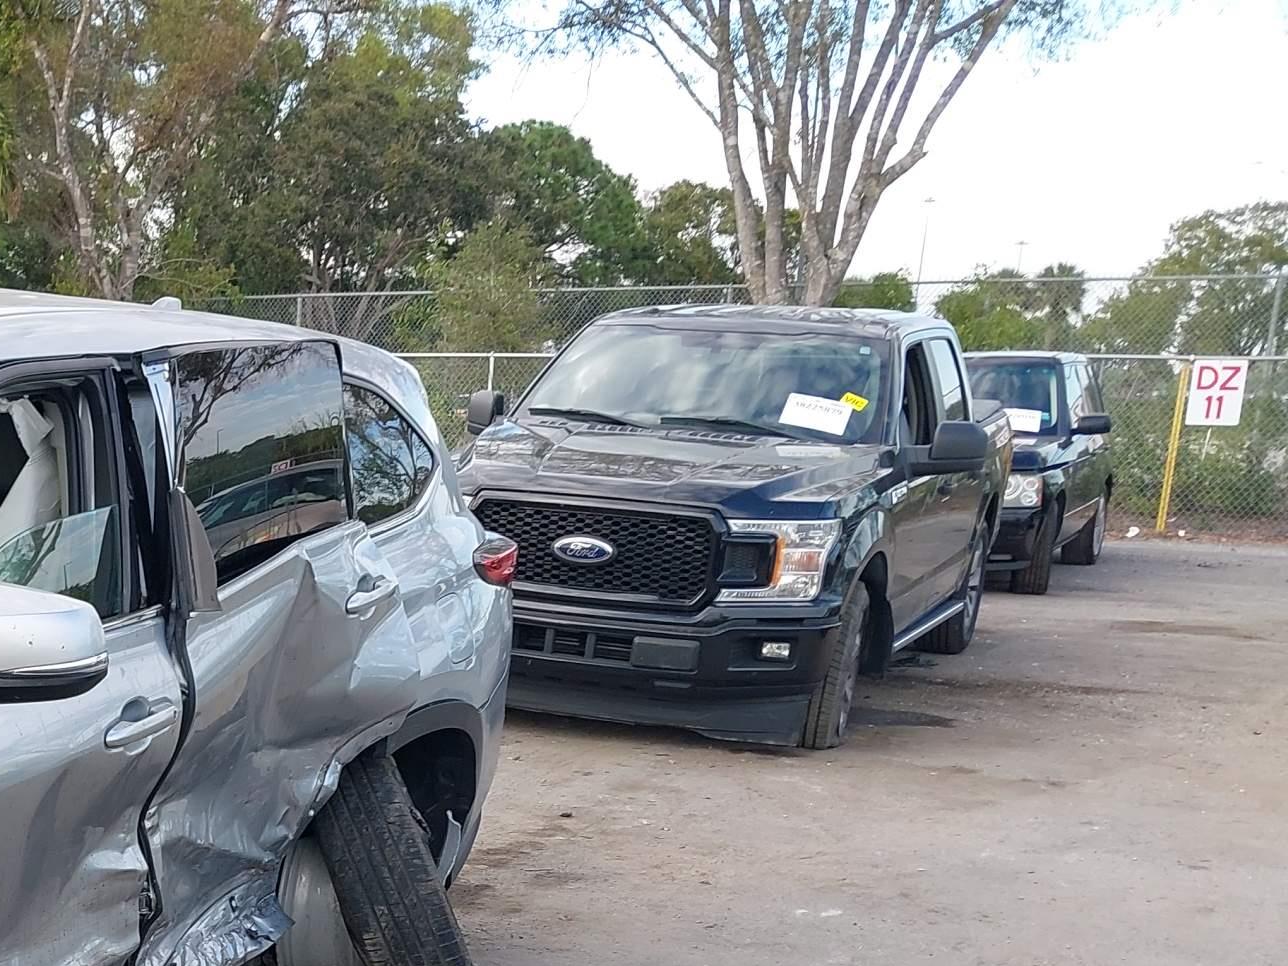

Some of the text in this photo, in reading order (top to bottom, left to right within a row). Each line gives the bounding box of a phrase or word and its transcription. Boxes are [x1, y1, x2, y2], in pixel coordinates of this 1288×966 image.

[1196, 365, 1242, 391] DZ
[1204, 395, 1224, 419] 11
[566, 542, 599, 558] Ford
